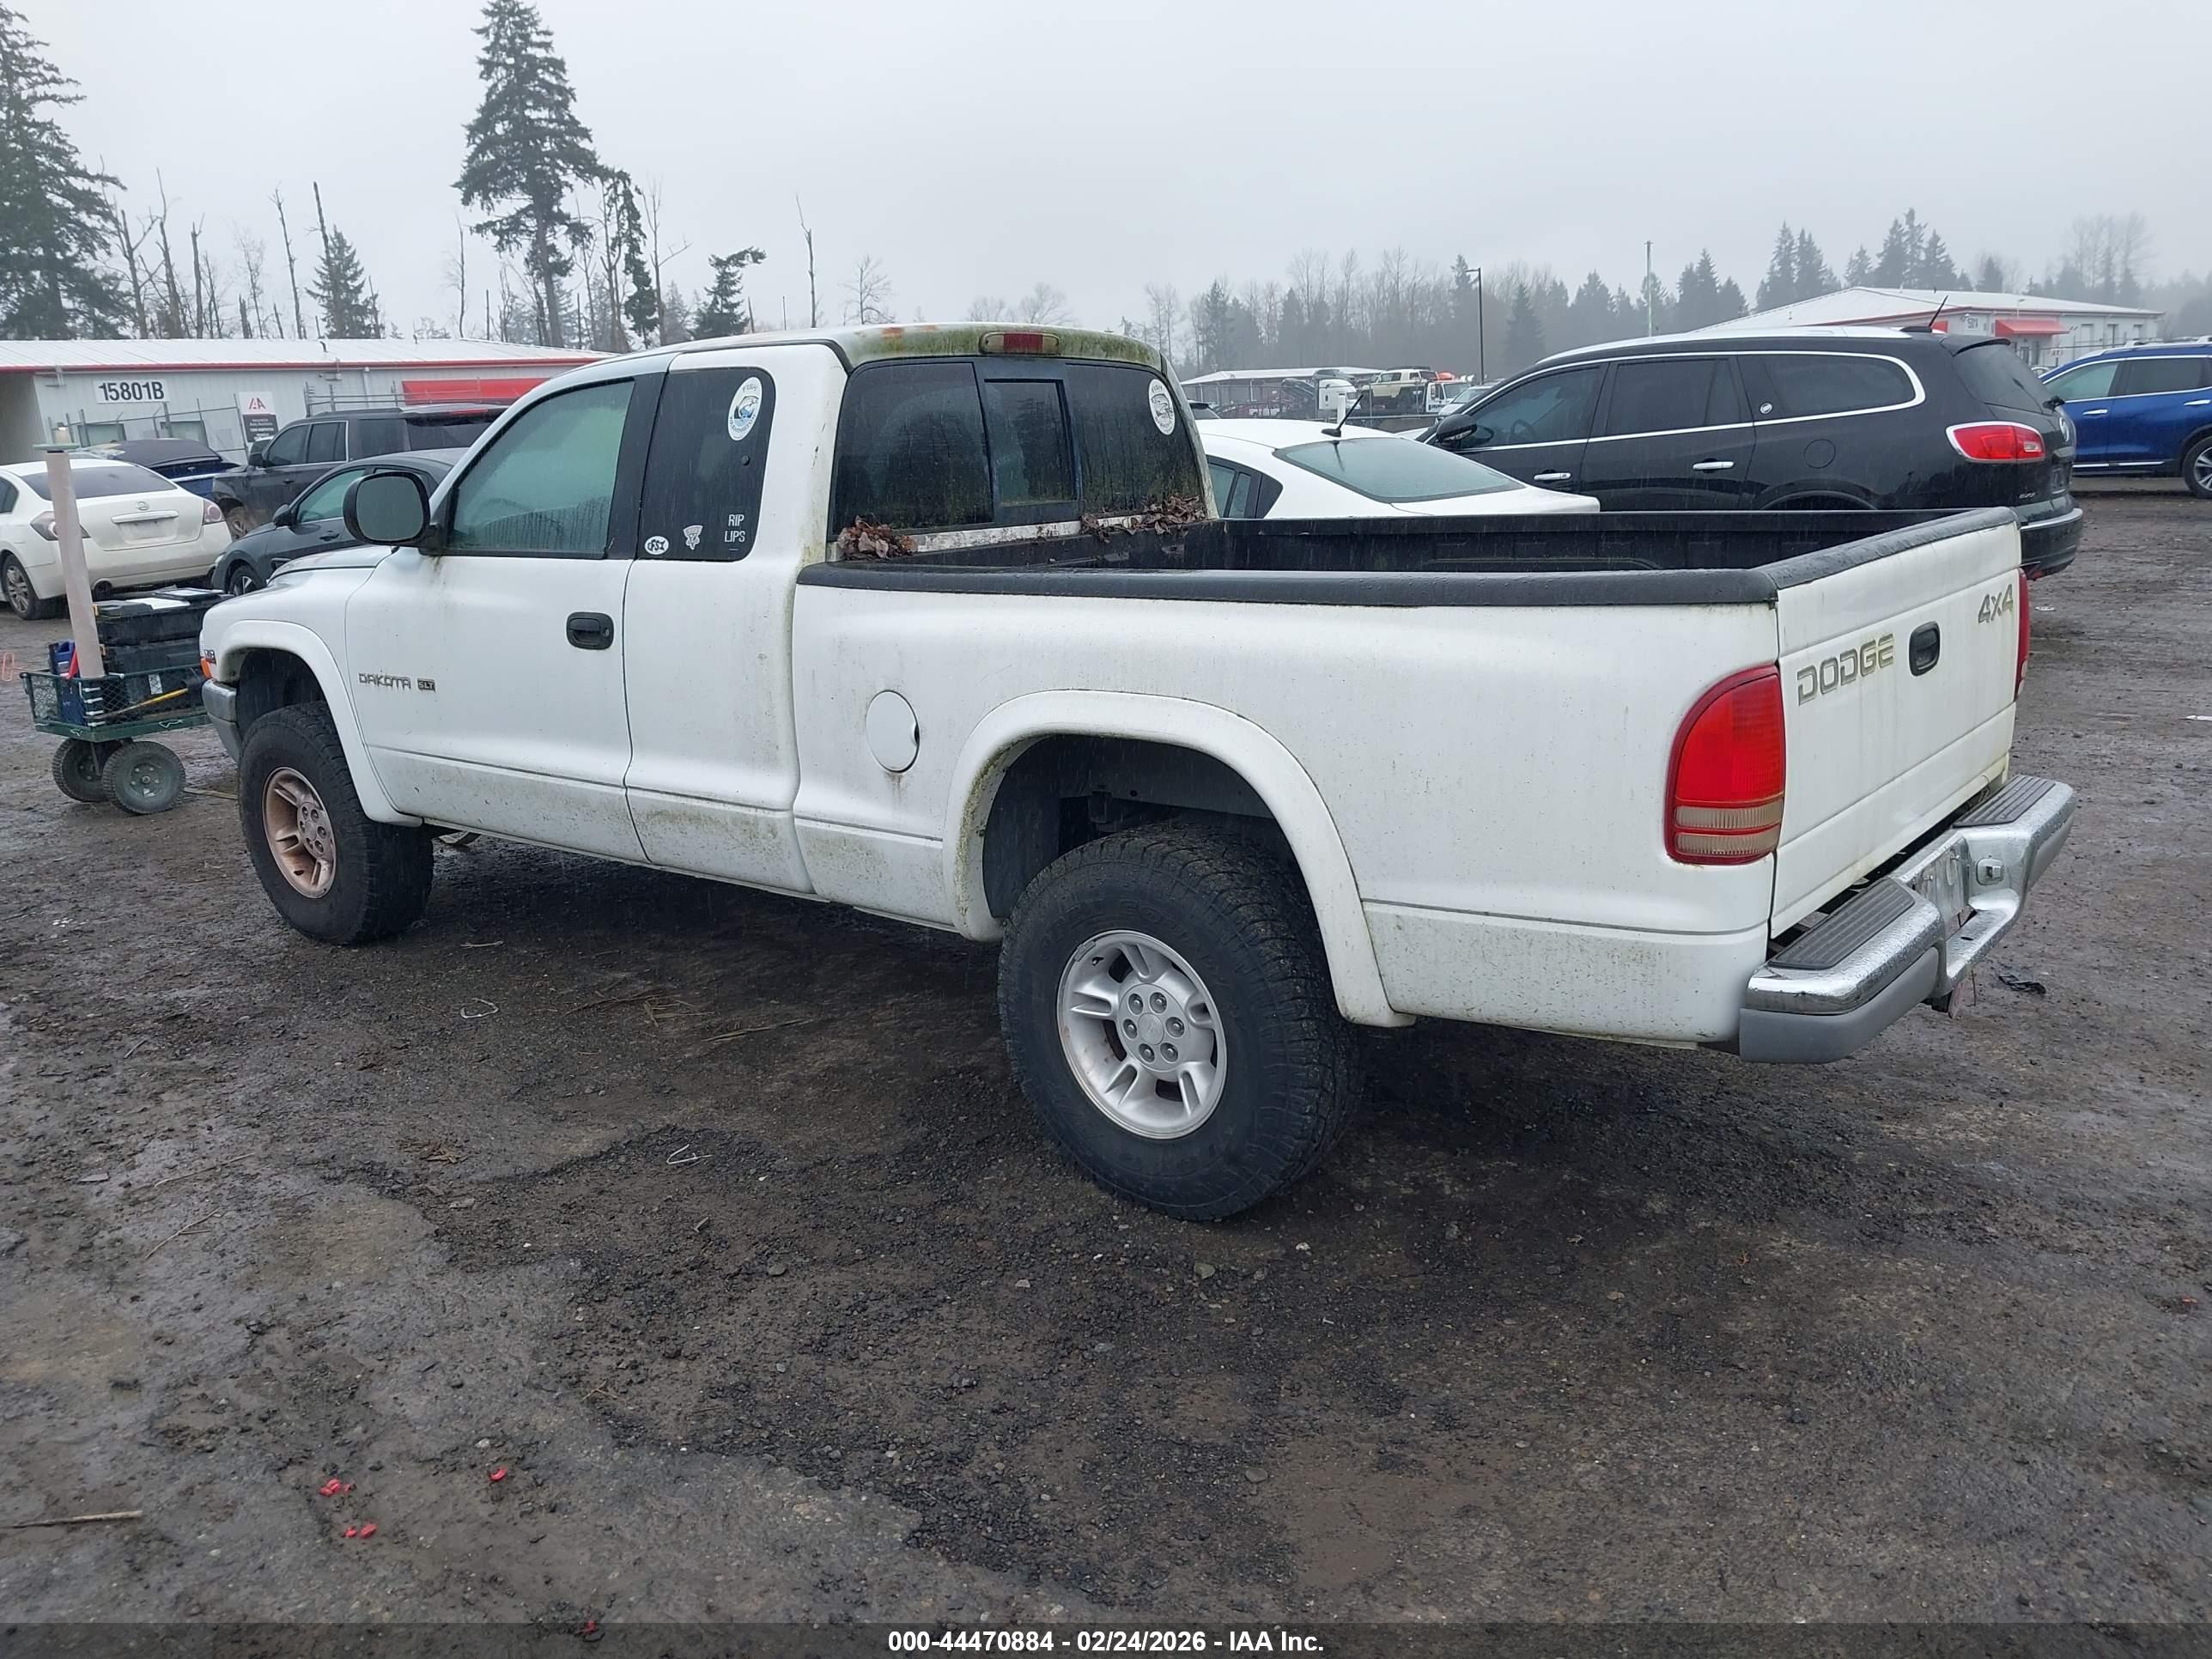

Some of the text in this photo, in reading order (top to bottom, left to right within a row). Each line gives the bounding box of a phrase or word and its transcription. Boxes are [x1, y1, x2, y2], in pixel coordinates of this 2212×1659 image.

[98, 381, 165, 401] 15801B
[727, 514, 745, 527] RIP
[724, 530, 746, 543] LIPS
[1796, 633, 1894, 707] DODGE
[358, 673, 435, 691] DAKOTA SLT
